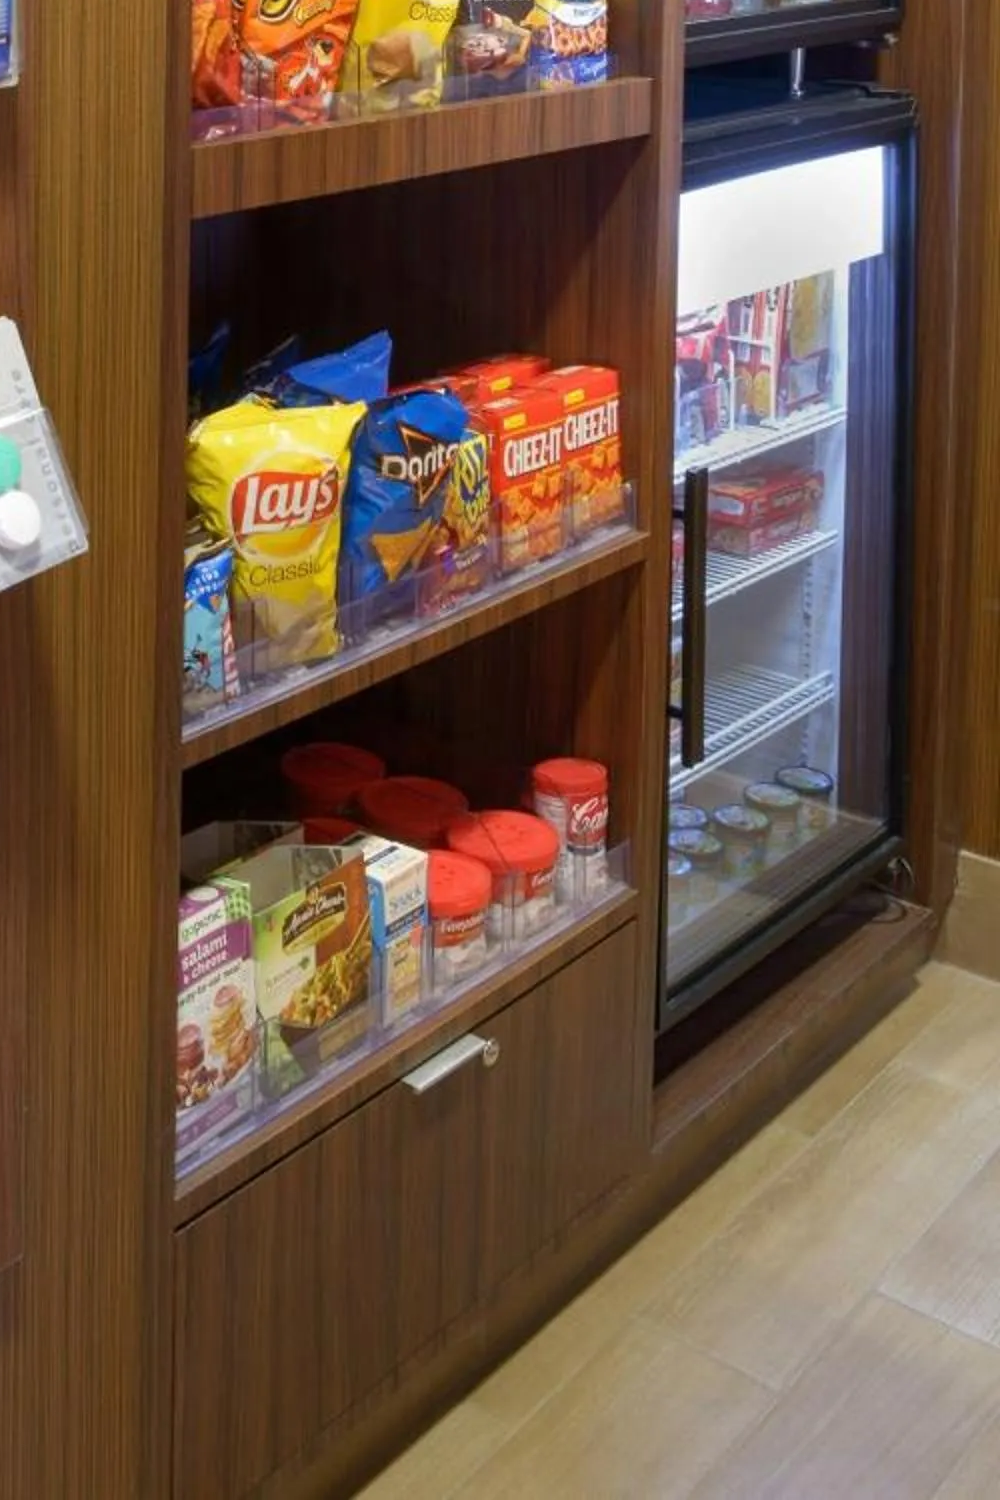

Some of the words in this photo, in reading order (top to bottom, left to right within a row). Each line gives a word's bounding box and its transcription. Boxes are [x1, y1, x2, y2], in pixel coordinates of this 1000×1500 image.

[408, 0, 455, 21] Class
[563, 400, 620, 452] CHEEZ-IT
[382, 443, 460, 484] Dorito
[503, 427, 563, 478] CHEEZ-IT
[241, 464, 337, 534] Lay's
[182, 930, 227, 969] salami
